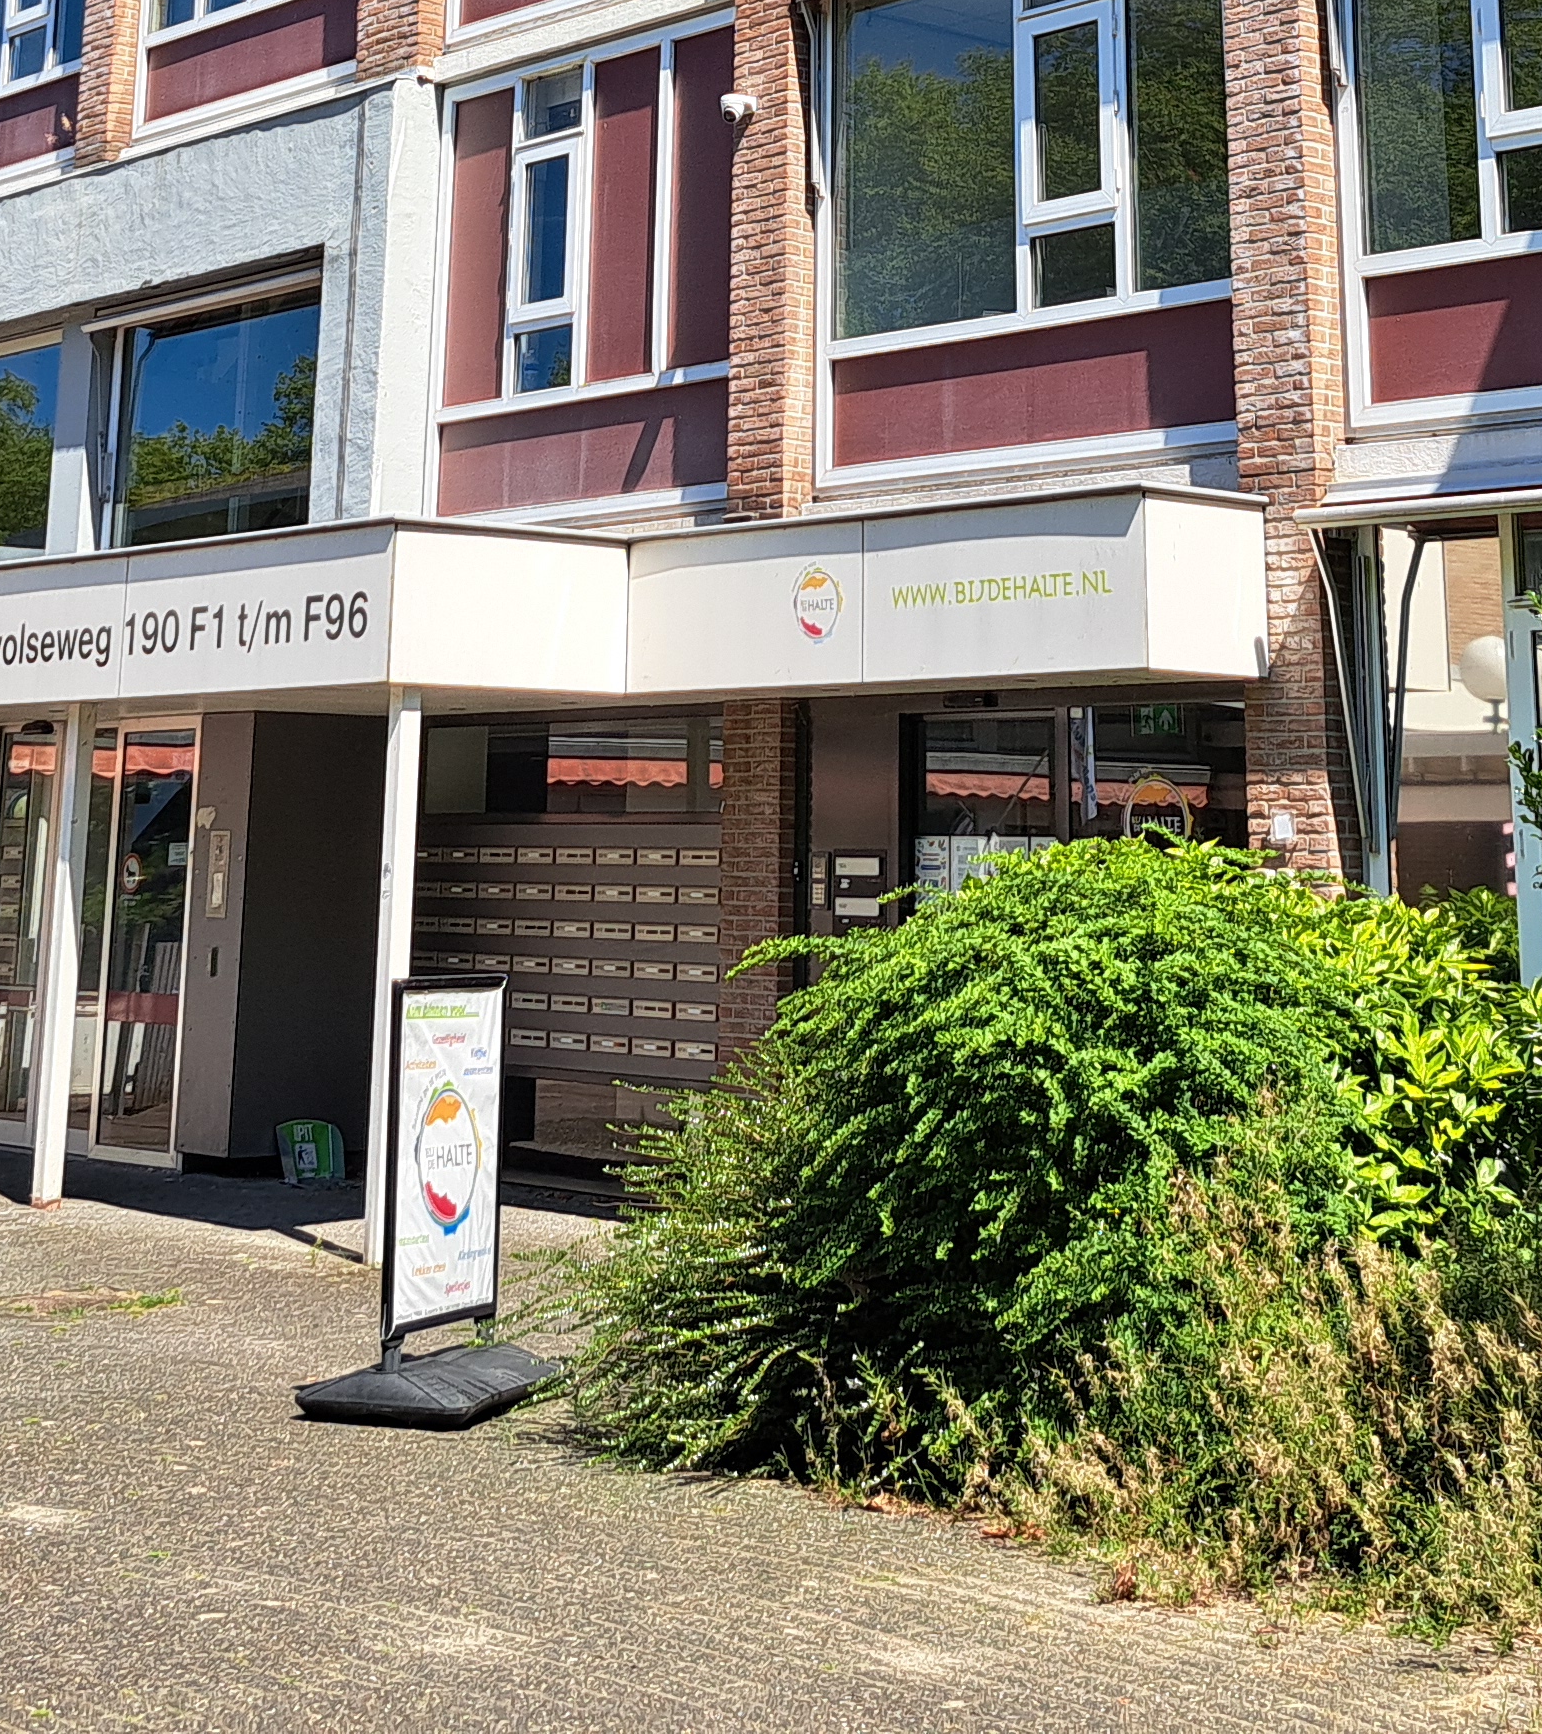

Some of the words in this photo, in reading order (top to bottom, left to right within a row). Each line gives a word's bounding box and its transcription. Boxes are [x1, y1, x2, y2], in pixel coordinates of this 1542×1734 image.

[808, 598, 835, 613] HALTE
[891, 569, 1113, 610] WWW.BIJDEHALTE.NL
[124, 608, 180, 656] 190
[189, 604, 225, 651] F1
[238, 599, 291, 654] t/m
[303, 591, 370, 642] F96
[436, 1143, 473, 1170] HALTE
